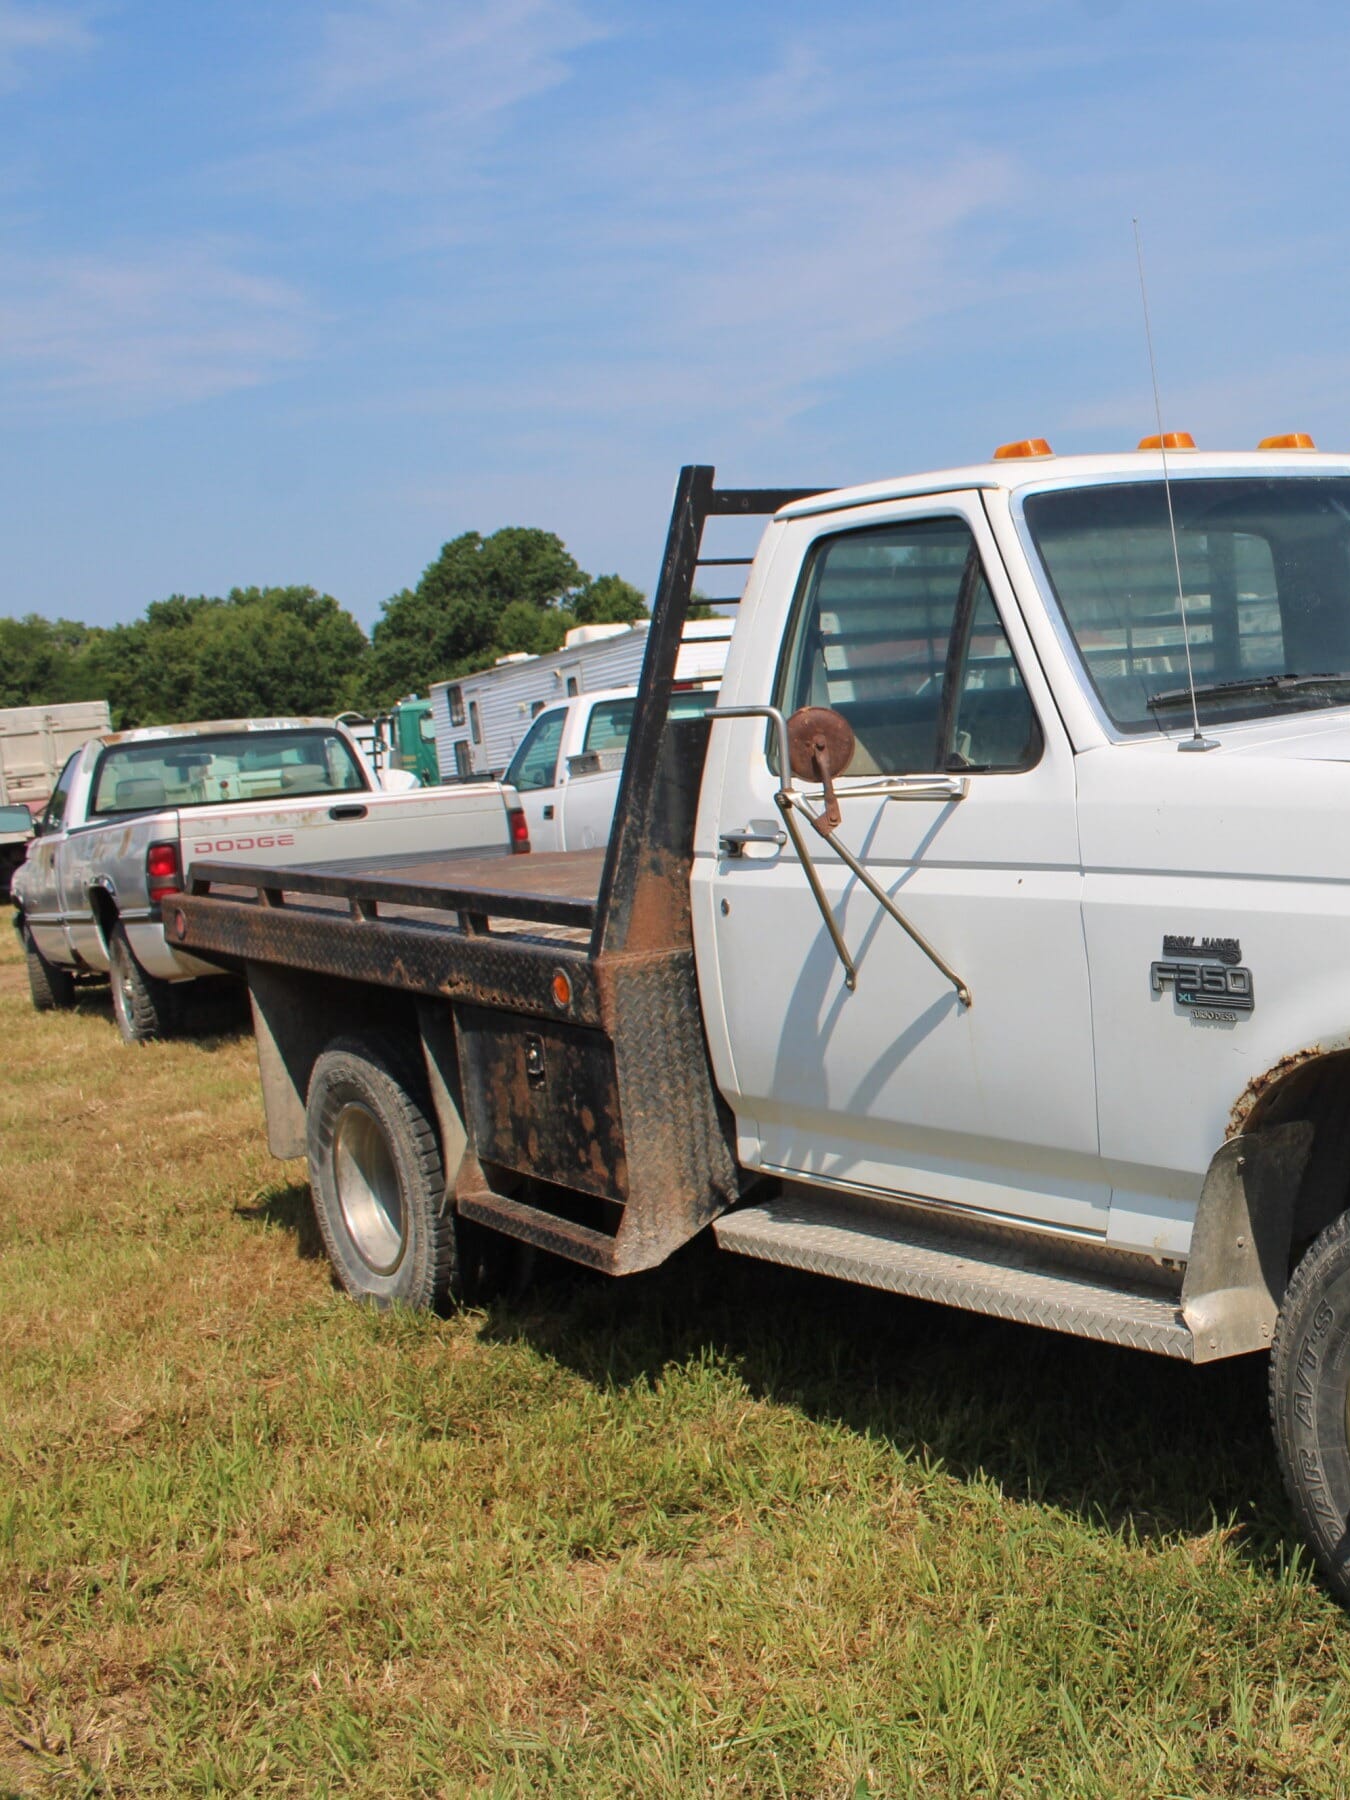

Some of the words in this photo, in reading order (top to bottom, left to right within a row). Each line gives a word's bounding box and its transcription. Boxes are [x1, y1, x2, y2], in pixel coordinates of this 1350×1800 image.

[194, 834, 295, 854] DODGE
[1151, 962, 1251, 993] F350
[1178, 992, 1195, 1003] XL
